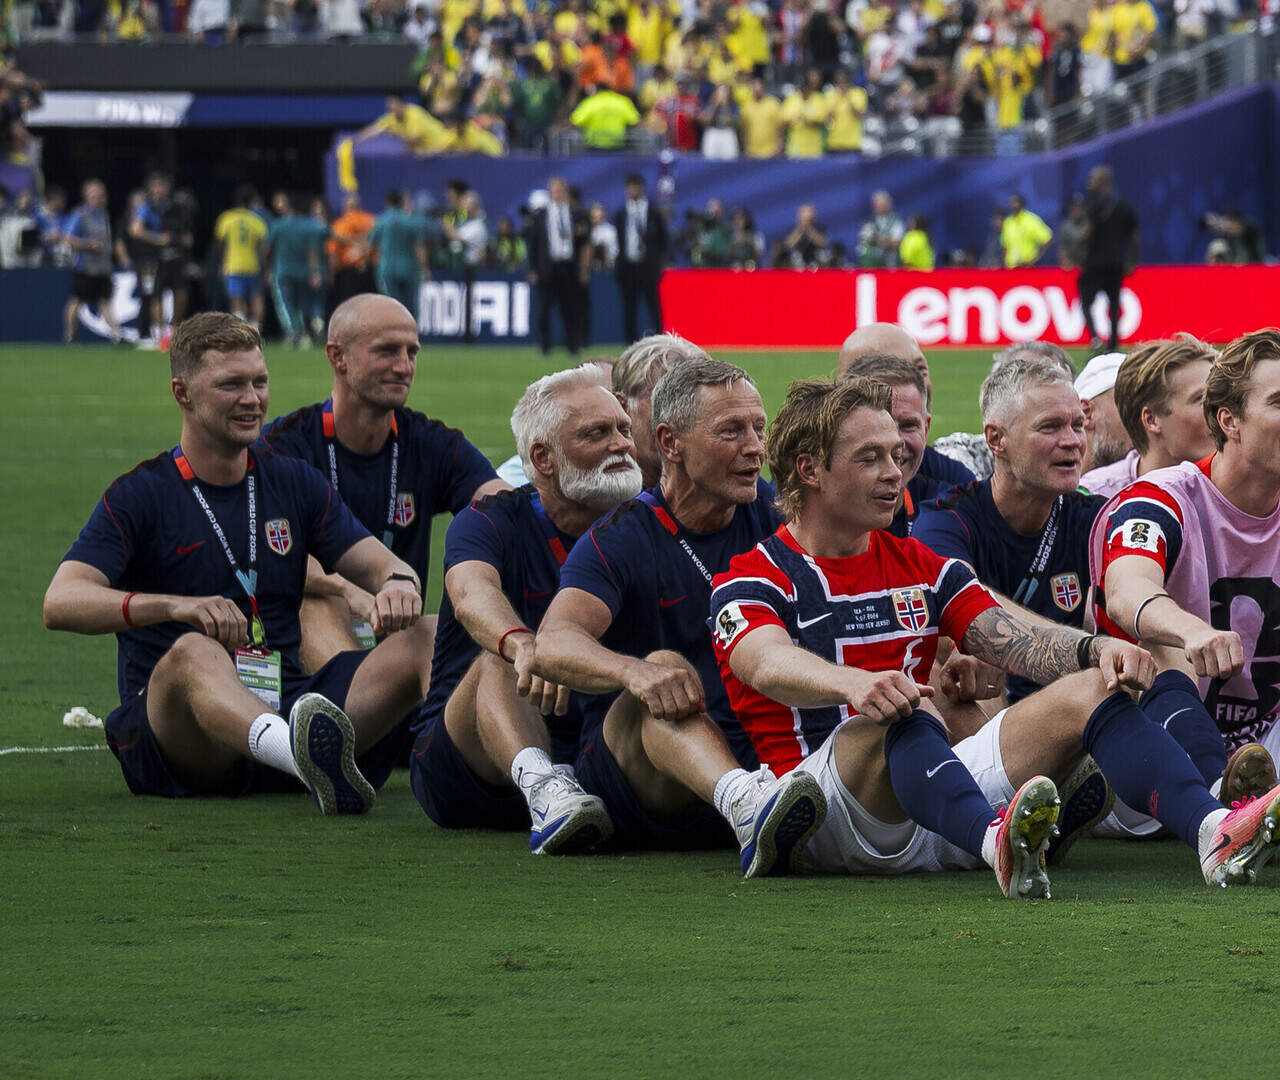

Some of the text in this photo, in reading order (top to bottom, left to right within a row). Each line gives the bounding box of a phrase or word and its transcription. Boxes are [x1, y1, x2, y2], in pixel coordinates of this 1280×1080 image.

[855, 272, 1143, 344] Lenovo
[249, 519, 257, 535] CUP
[680, 539, 713, 581] FIFA WORLD
[1216, 703, 1257, 722] FIFA
